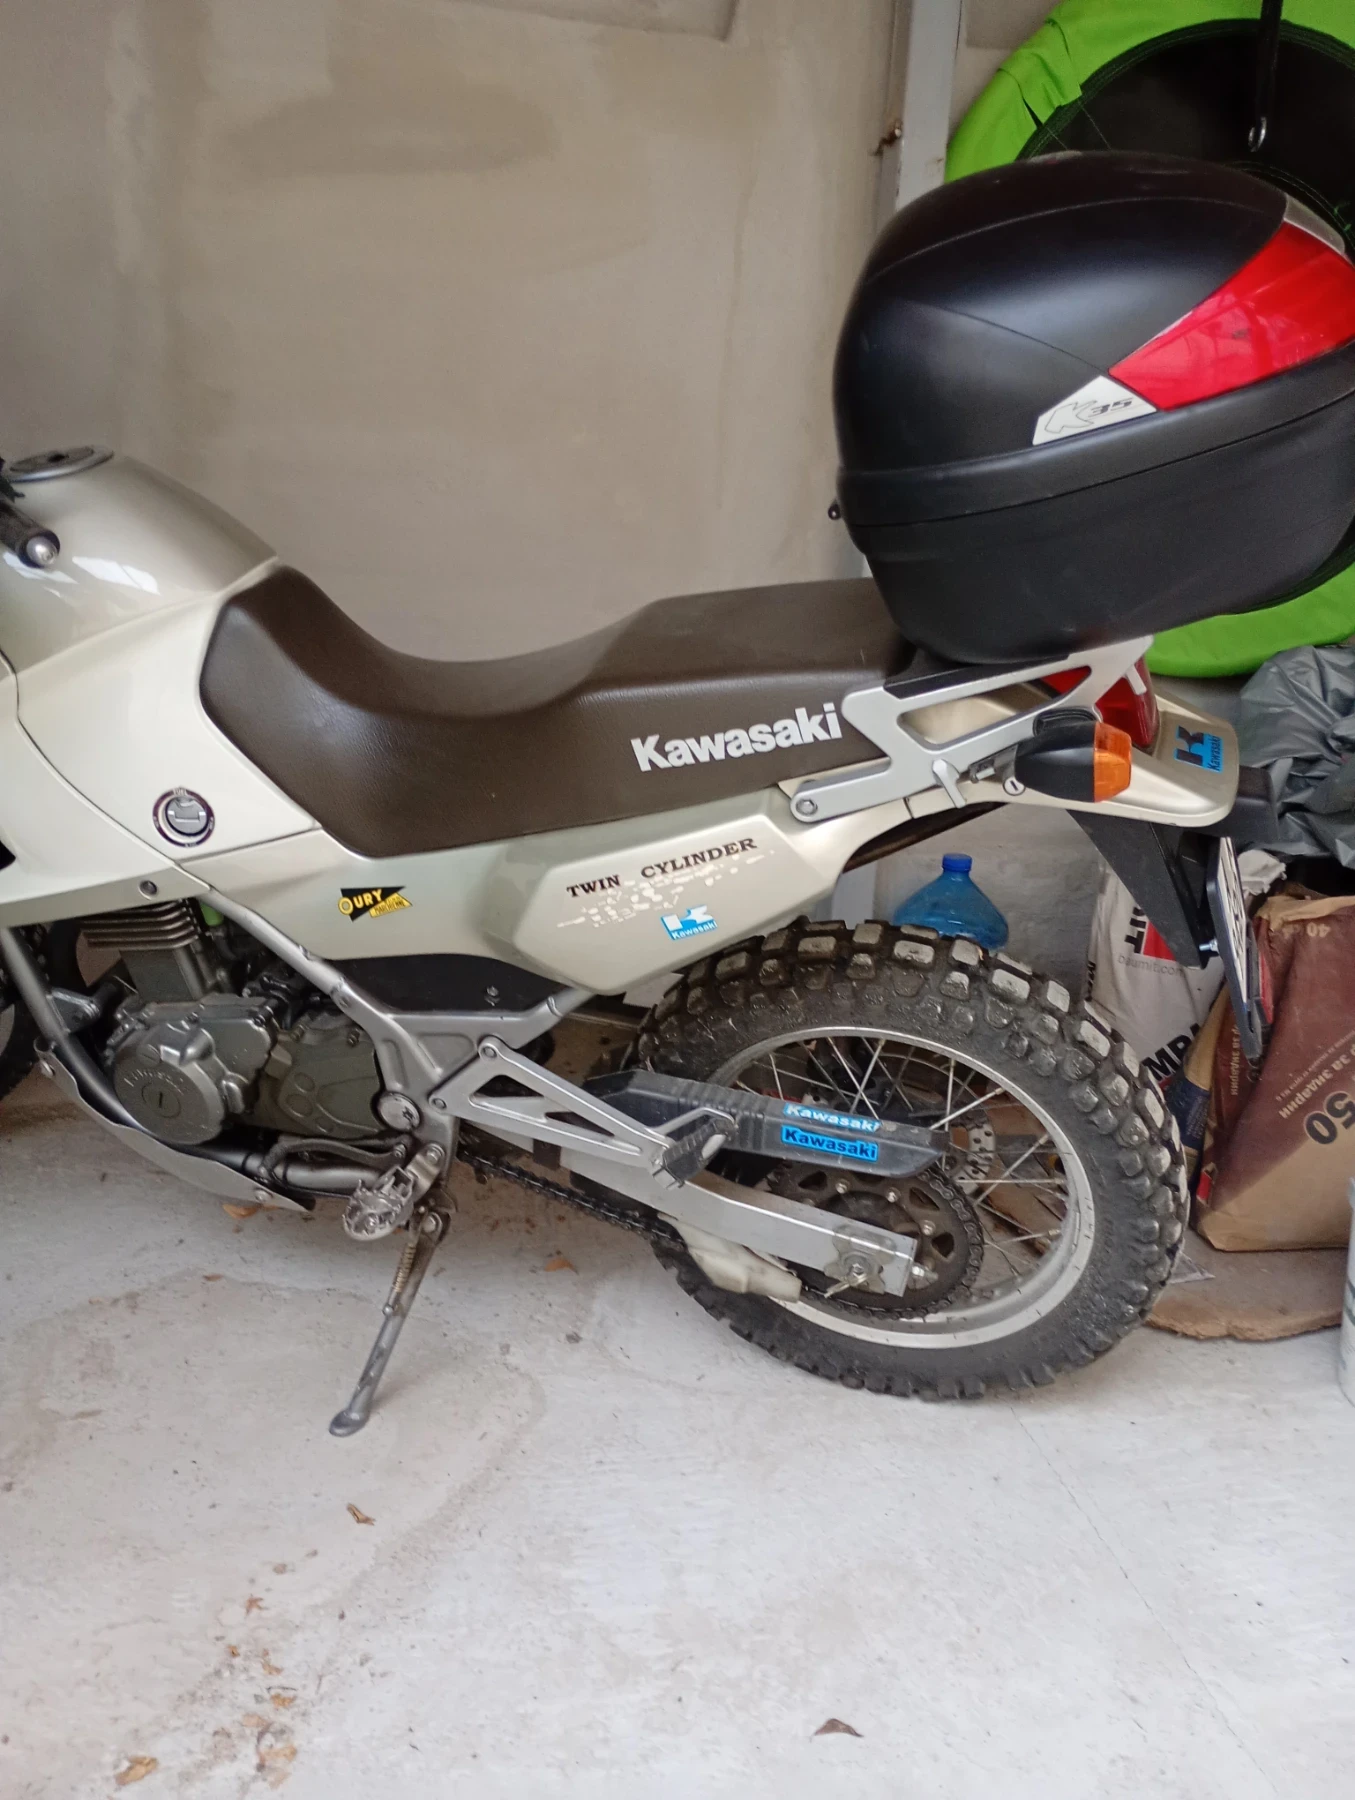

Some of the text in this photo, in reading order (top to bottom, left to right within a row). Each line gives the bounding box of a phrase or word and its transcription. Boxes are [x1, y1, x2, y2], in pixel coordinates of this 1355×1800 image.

[631, 702, 842, 772] Kawasaki
[567, 838, 757, 898] TWIN CYLINDER
[338, 889, 383, 916] OURY
[671, 920, 718, 940] Kawasaki
[786, 1103, 881, 1132] Kawasaki
[785, 1128, 876, 1158] Kawasaki
